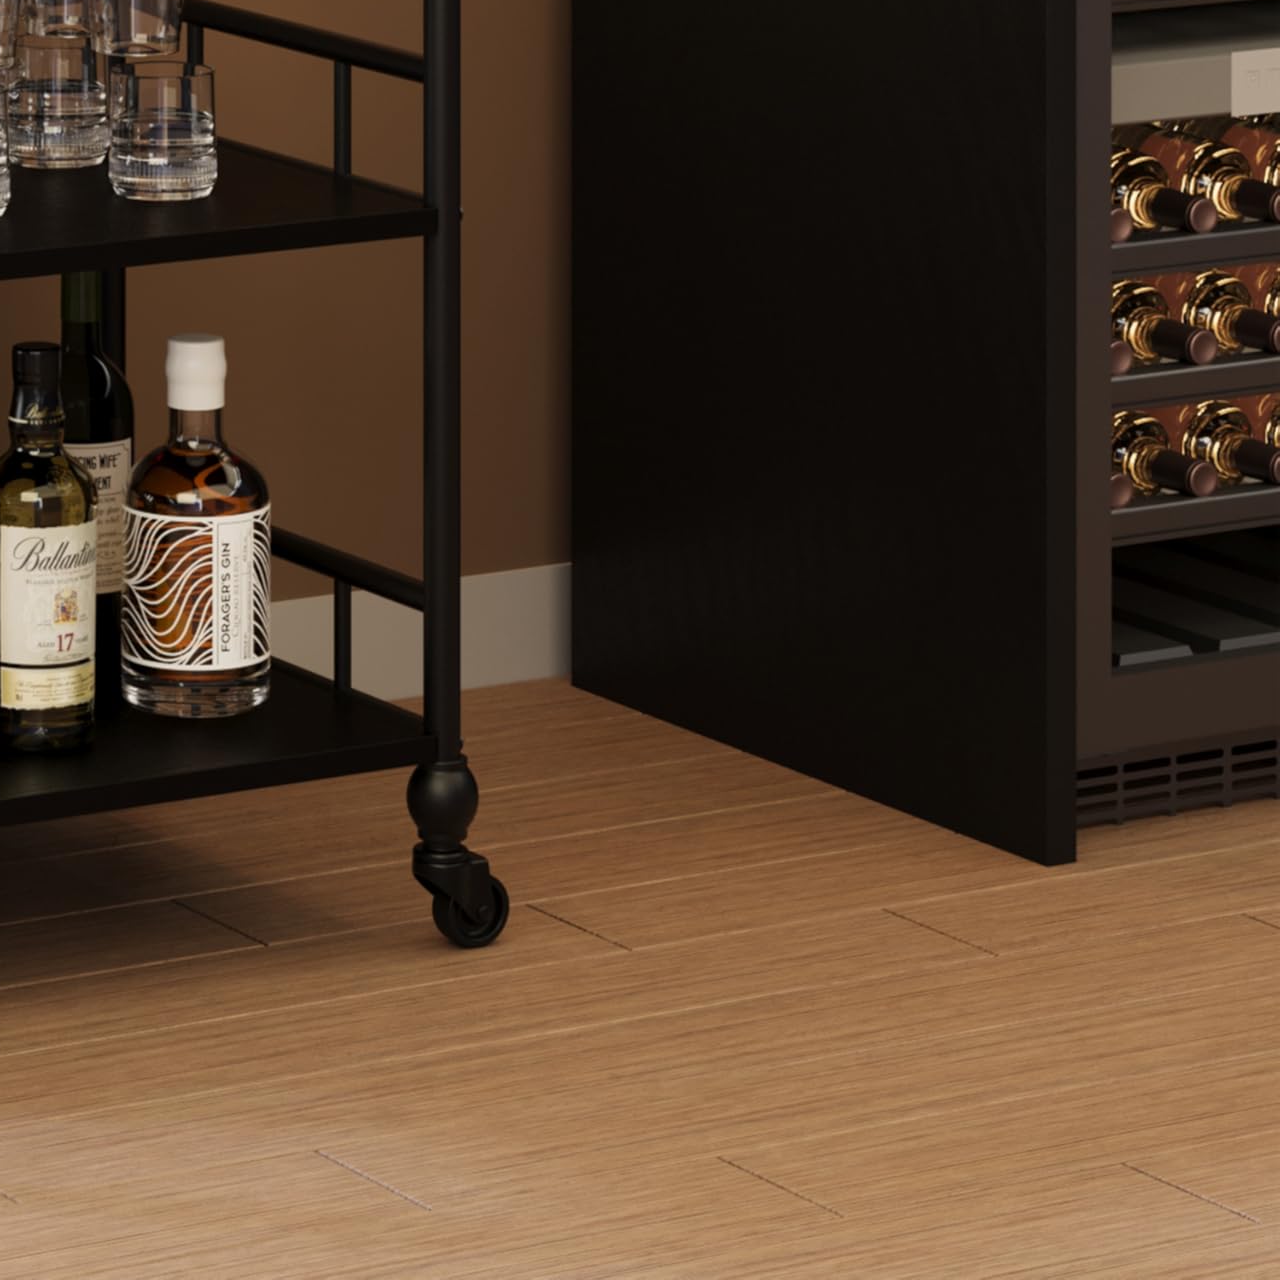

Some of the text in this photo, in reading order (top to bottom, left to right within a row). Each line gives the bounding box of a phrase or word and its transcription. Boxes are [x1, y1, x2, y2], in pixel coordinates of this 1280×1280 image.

[99, 452, 118, 468] WIFE
[221, 543, 231, 653] FORAGER'S GIN
[57, 632, 75, 652] 17
